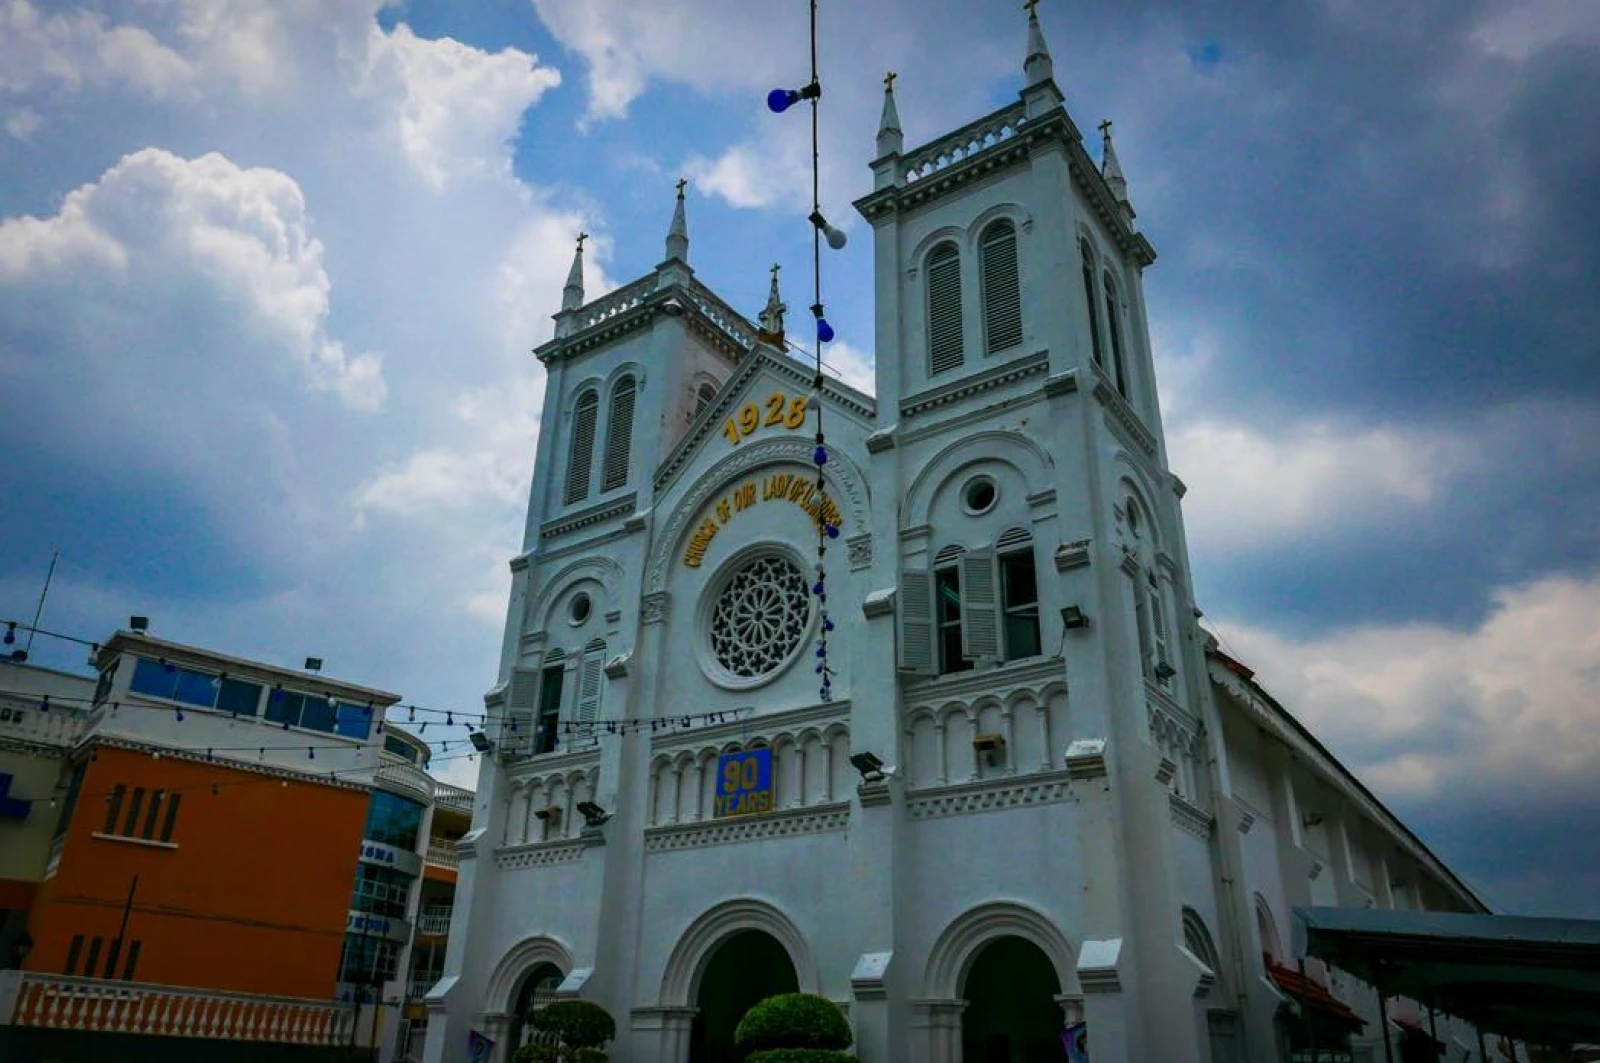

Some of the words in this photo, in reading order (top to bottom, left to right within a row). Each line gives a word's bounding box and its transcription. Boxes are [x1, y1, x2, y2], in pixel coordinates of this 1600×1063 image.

[723, 391, 806, 446] 1928
[734, 480, 757, 512] OUR
[763, 474, 794, 501] LADY
[723, 757, 758, 793] 90
[714, 791, 773, 815] YEARS
